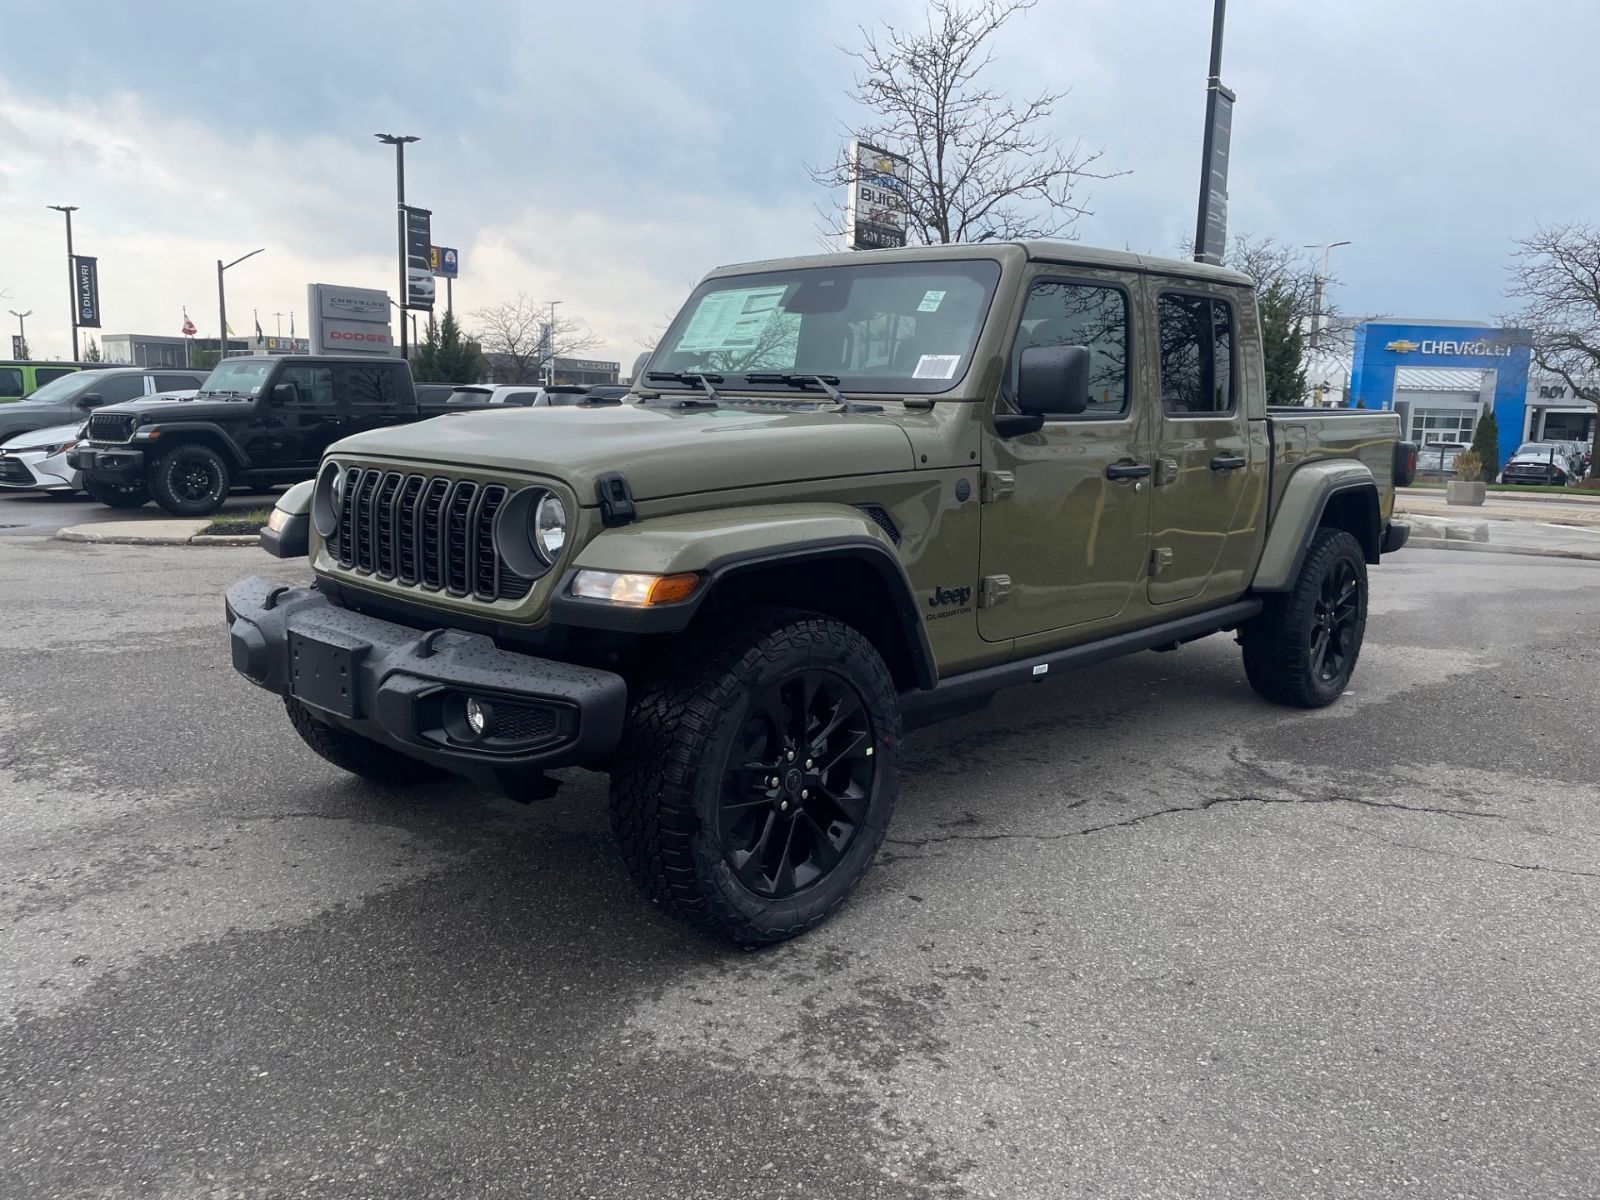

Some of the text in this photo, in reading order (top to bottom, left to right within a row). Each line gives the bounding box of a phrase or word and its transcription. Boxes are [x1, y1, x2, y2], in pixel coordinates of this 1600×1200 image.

[81, 265, 91, 307] DILAWRI
[330, 297, 385, 307] CHRYSLER
[330, 331, 386, 343] DODGE
[1540, 385, 1567, 398] ROY
[928, 586, 971, 607] Jeep
[926, 607, 971, 620] GLADIATOR
